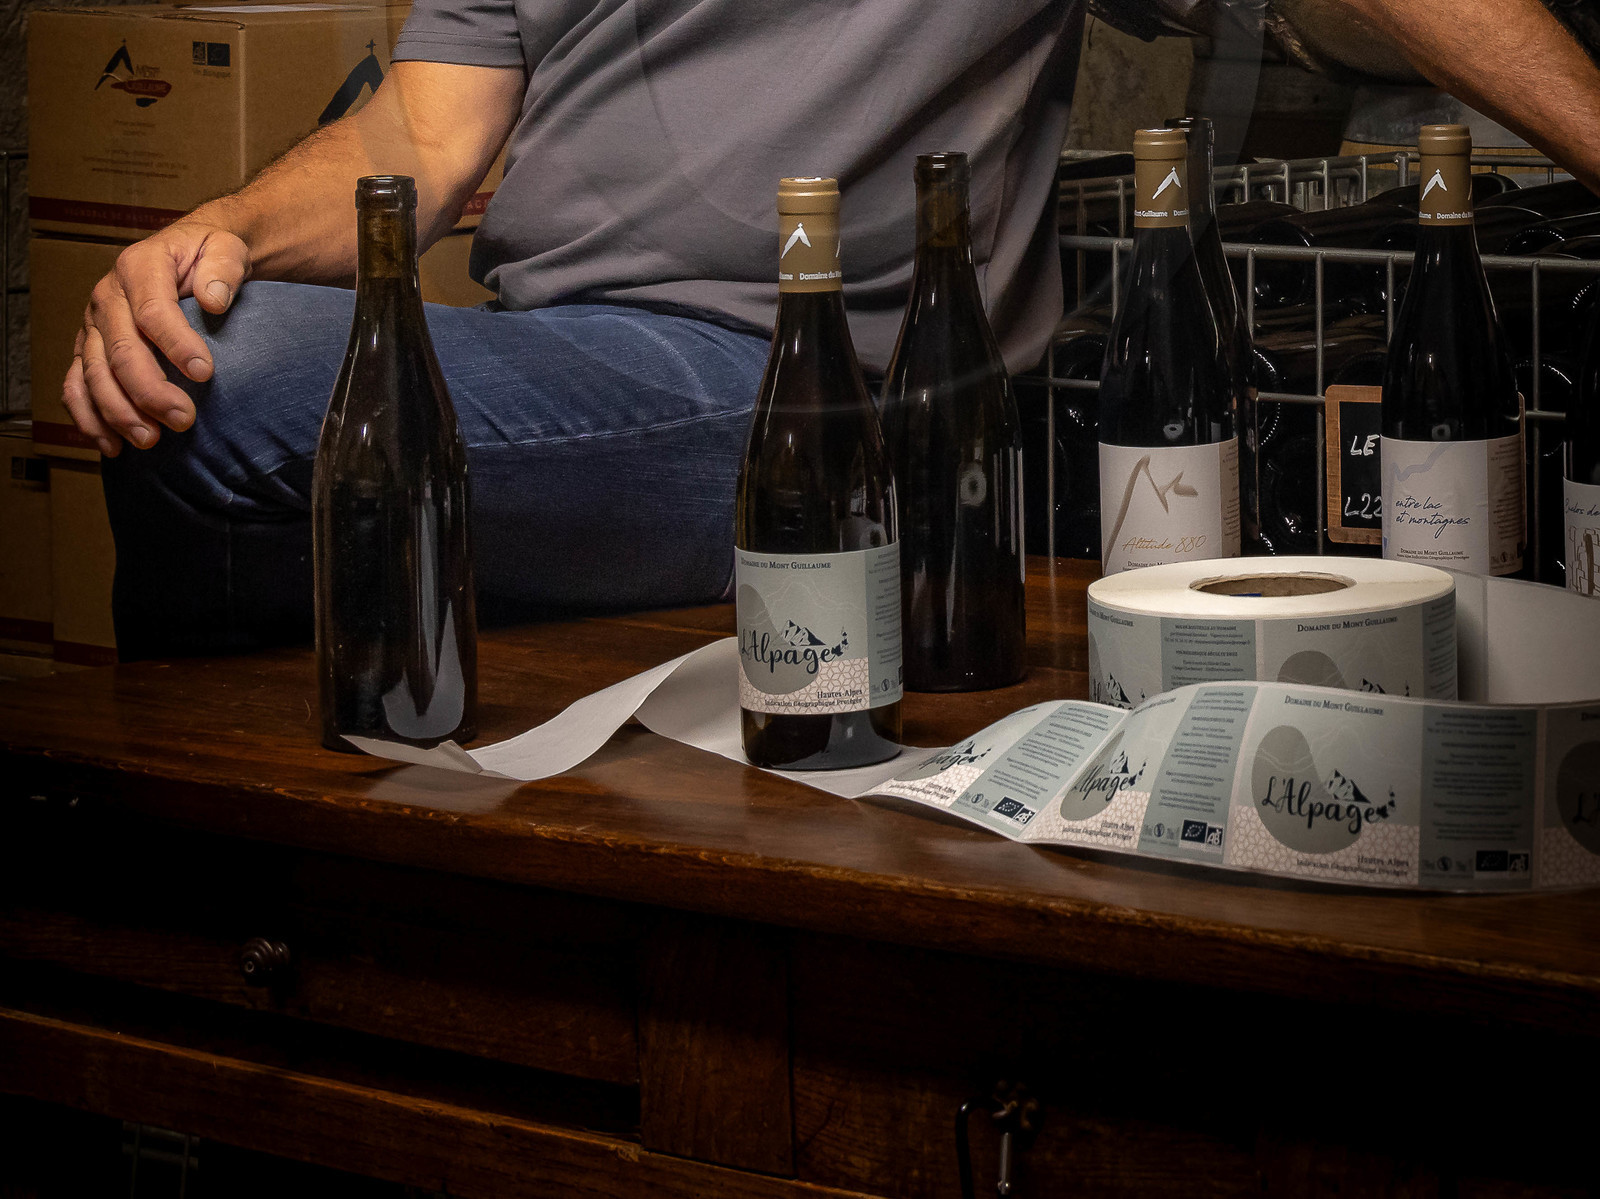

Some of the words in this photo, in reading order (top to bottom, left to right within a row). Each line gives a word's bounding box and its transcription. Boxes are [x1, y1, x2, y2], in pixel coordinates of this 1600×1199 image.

[799, 271, 827, 280] Domaine
[1395, 496, 1422, 510] entre
[1422, 496, 1443, 510] lac
[1395, 510, 1409, 523] et
[1408, 512, 1471, 539] montagnes
[1122, 536, 1173, 554] Altitude
[1174, 535, 1207, 553] 880
[741, 629, 836, 674] L'Alpage
[1261, 776, 1383, 834] L'Alpage
